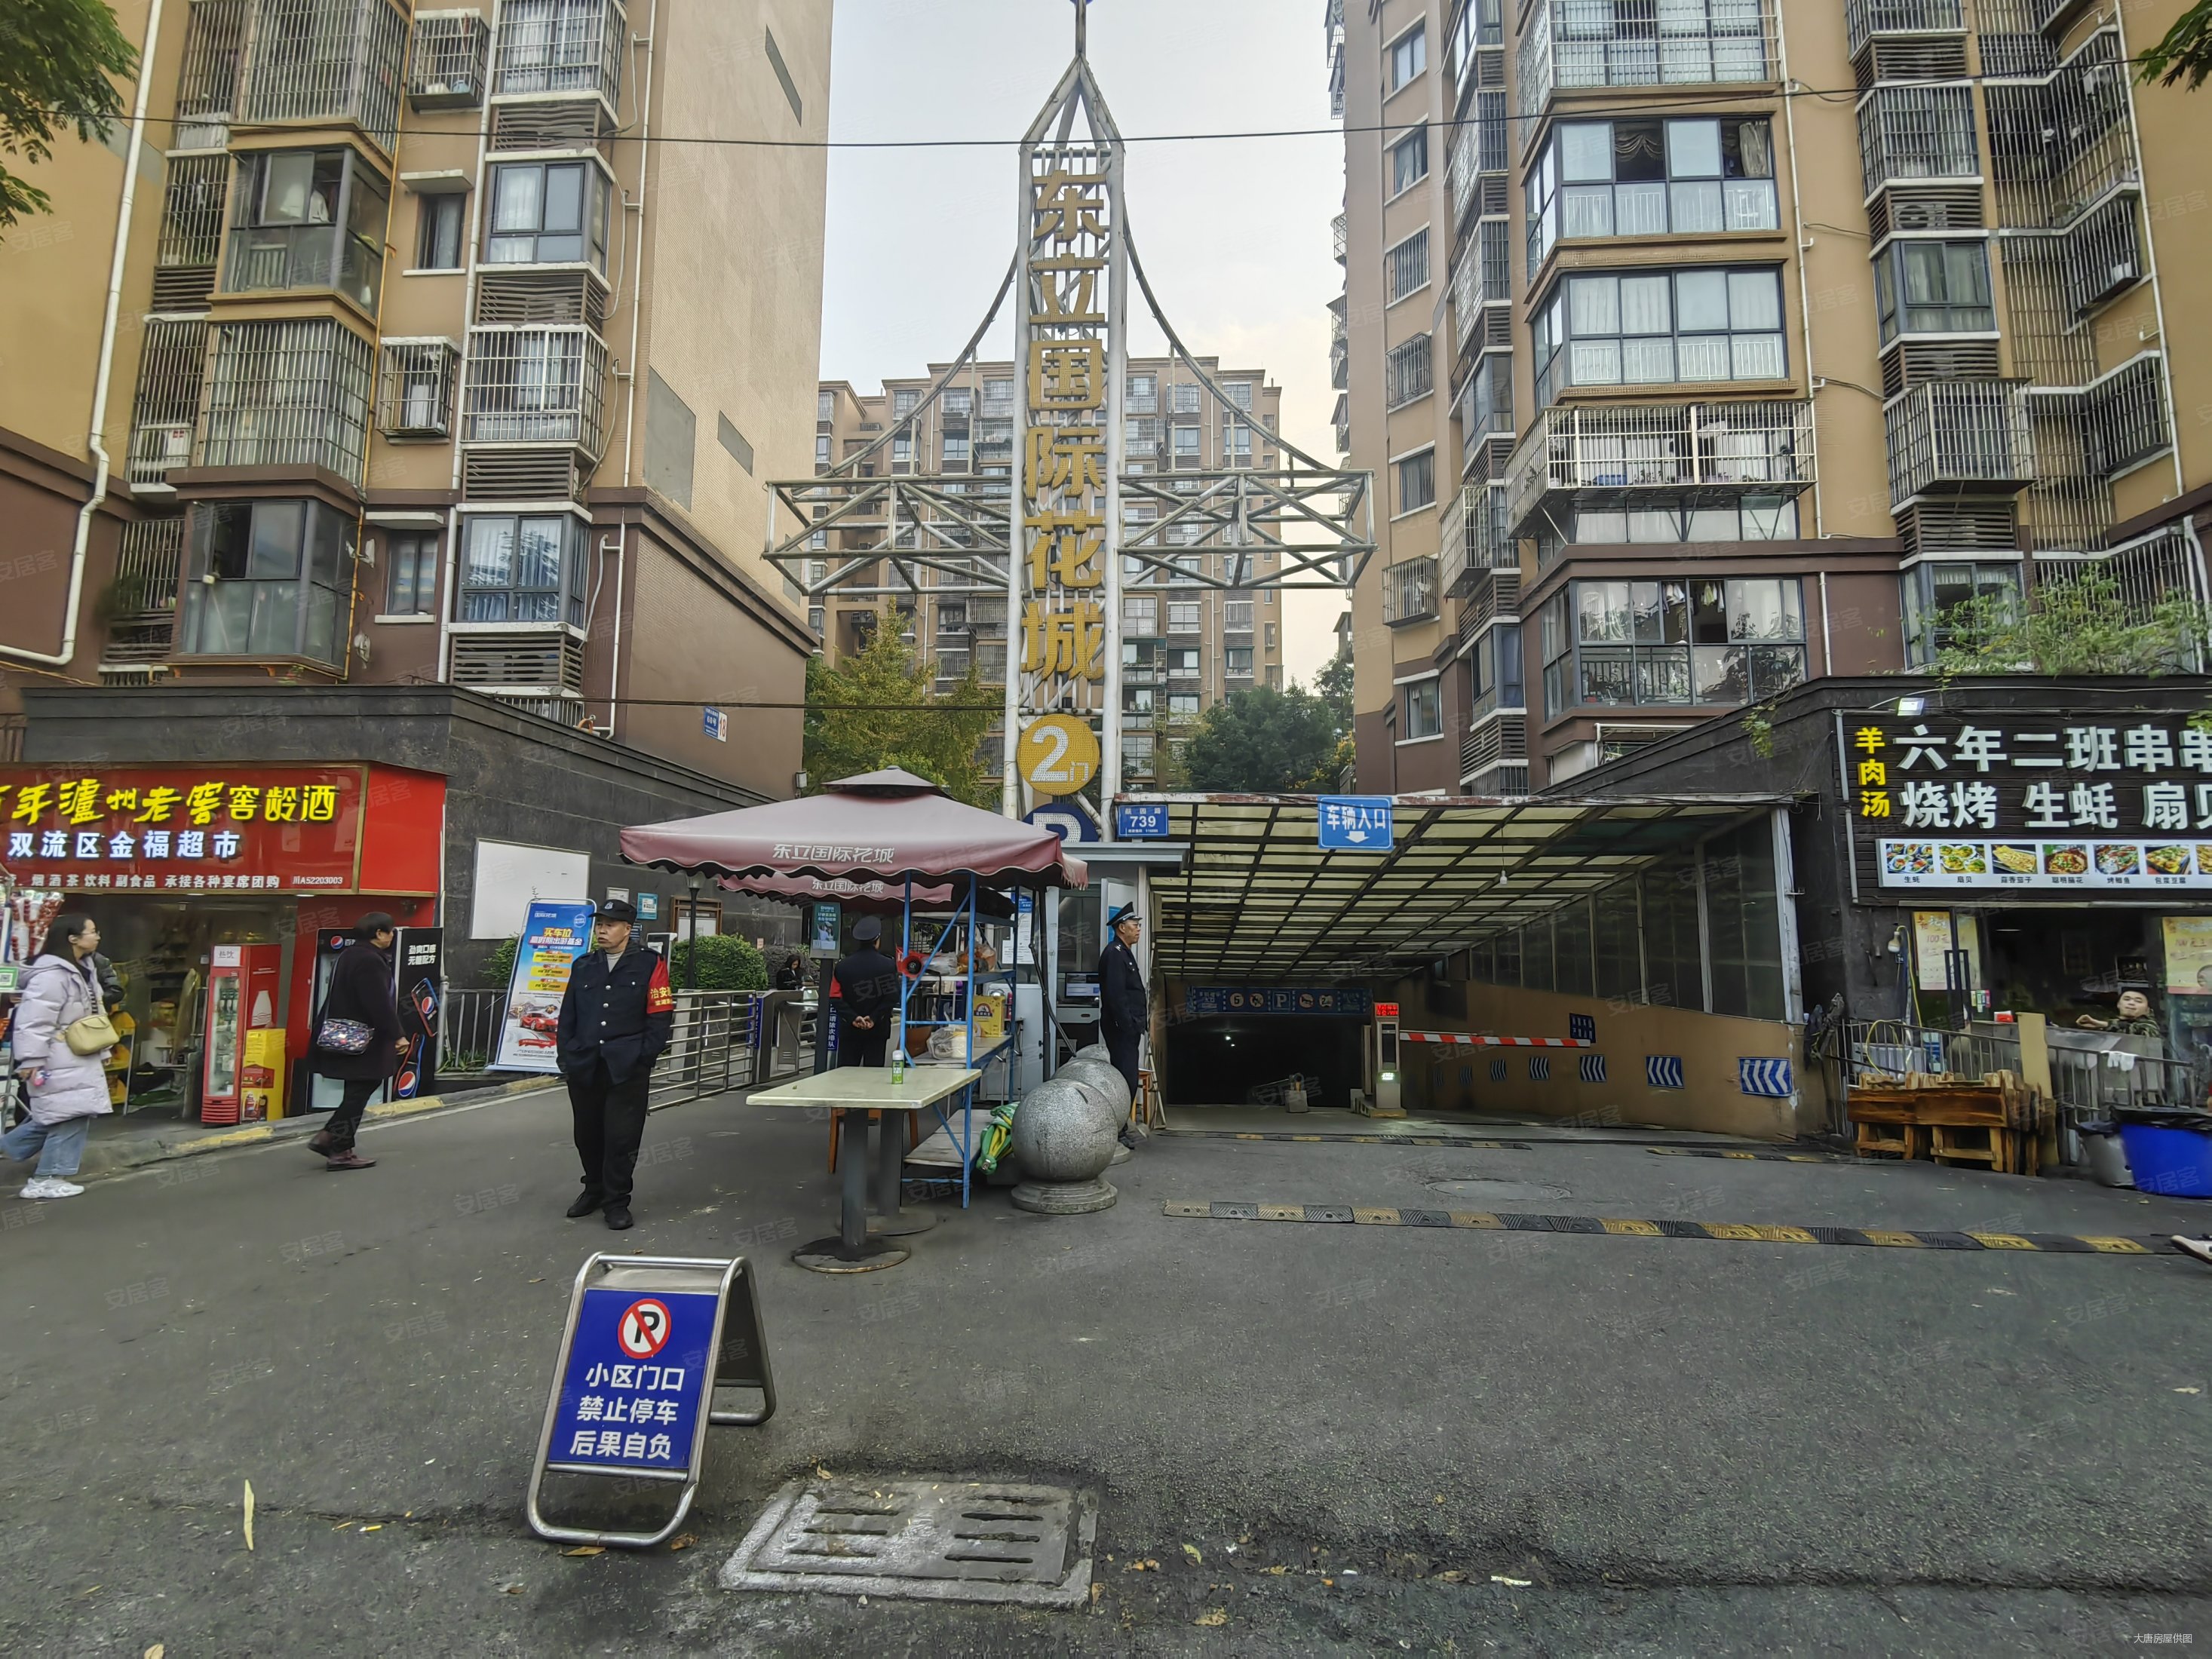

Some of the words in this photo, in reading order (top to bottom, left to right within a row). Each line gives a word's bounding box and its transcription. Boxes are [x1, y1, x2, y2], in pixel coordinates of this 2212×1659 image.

[1021, 170, 1106, 681] 东立国际花城
[719, 717, 726, 737] 18
[1030, 725, 1089, 782] 2门
[1893, 724, 2212, 772] 六年二班串串
[1854, 727, 1890, 818] 羊肉汤
[0, 779, 336, 826] 年泸州老窖窖龄酒
[1899, 781, 1998, 828] 烧烤
[2022, 781, 2118, 829] 生蚝
[1130, 815, 1156, 827] 739
[1327, 805, 1385, 830] 车辆入口
[8, 830, 239, 858] 双流区金福超市
[772, 844, 894, 863] 东立国际花城
[115, 875, 155, 888] 副食品
[165, 875, 280, 888] 承接各种宴席团购
[544, 928, 572, 937] 买车位
[585, 1363, 685, 1391] 小区门口
[576, 1395, 680, 1425] 禁止停车
[569, 1430, 671, 1460] 后果自负
